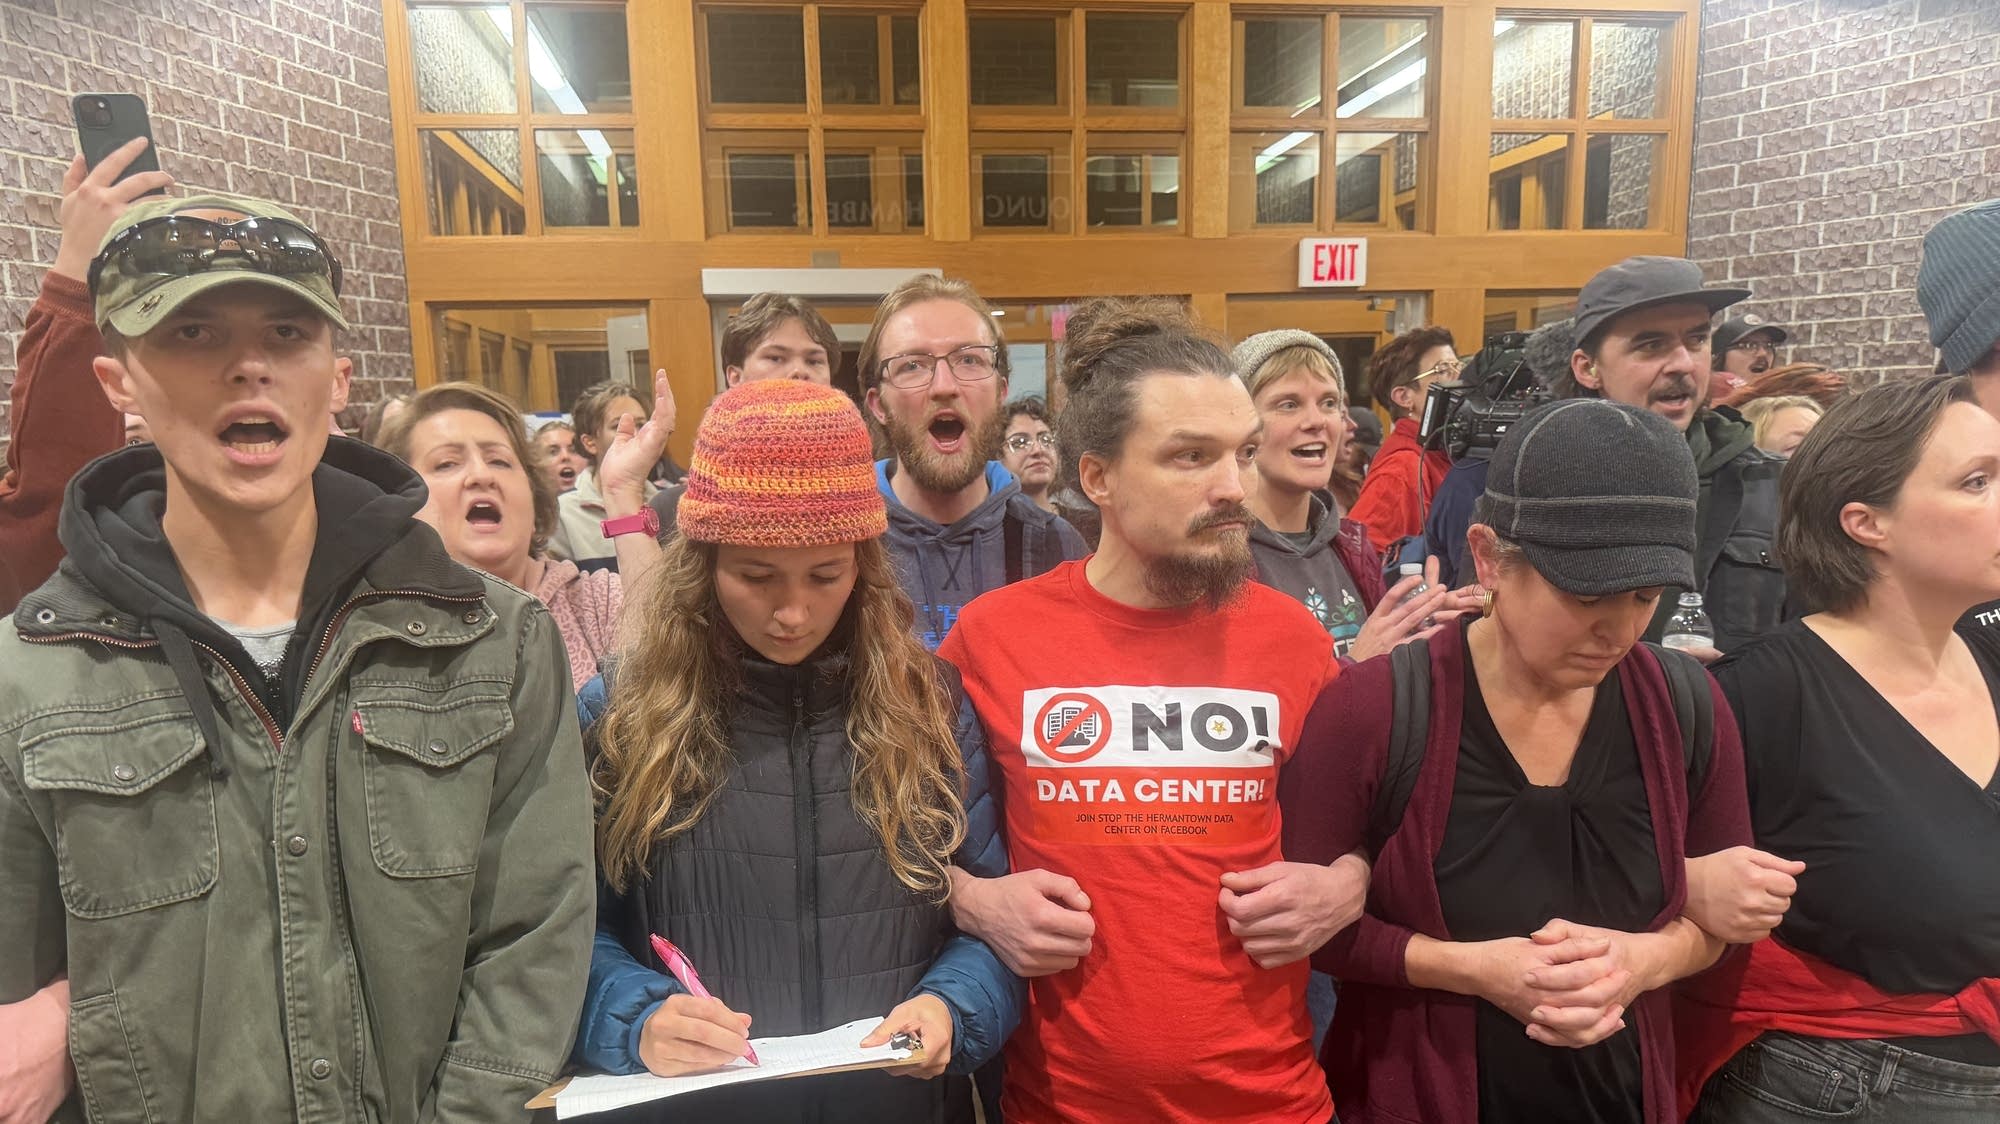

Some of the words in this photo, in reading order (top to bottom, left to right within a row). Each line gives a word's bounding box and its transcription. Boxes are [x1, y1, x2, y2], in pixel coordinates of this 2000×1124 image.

[1313, 244, 1359, 281] EXIT
[1974, 608, 2000, 626] TH
[1131, 702, 1269, 752] NO!
[1037, 779, 1126, 802] DATA
[1133, 779, 1264, 803] CENTER!
[1075, 813, 1096, 823] JOIN
[1098, 813, 1122, 823] STOP
[1124, 813, 1143, 823] THE
[1146, 813, 1212, 824] HERMANTOWN
[1214, 814, 1234, 824] DATA
[1104, 825, 1141, 835] CENTER
[1143, 825, 1158, 834] ON
[1160, 825, 1208, 835] FACEBOOK
